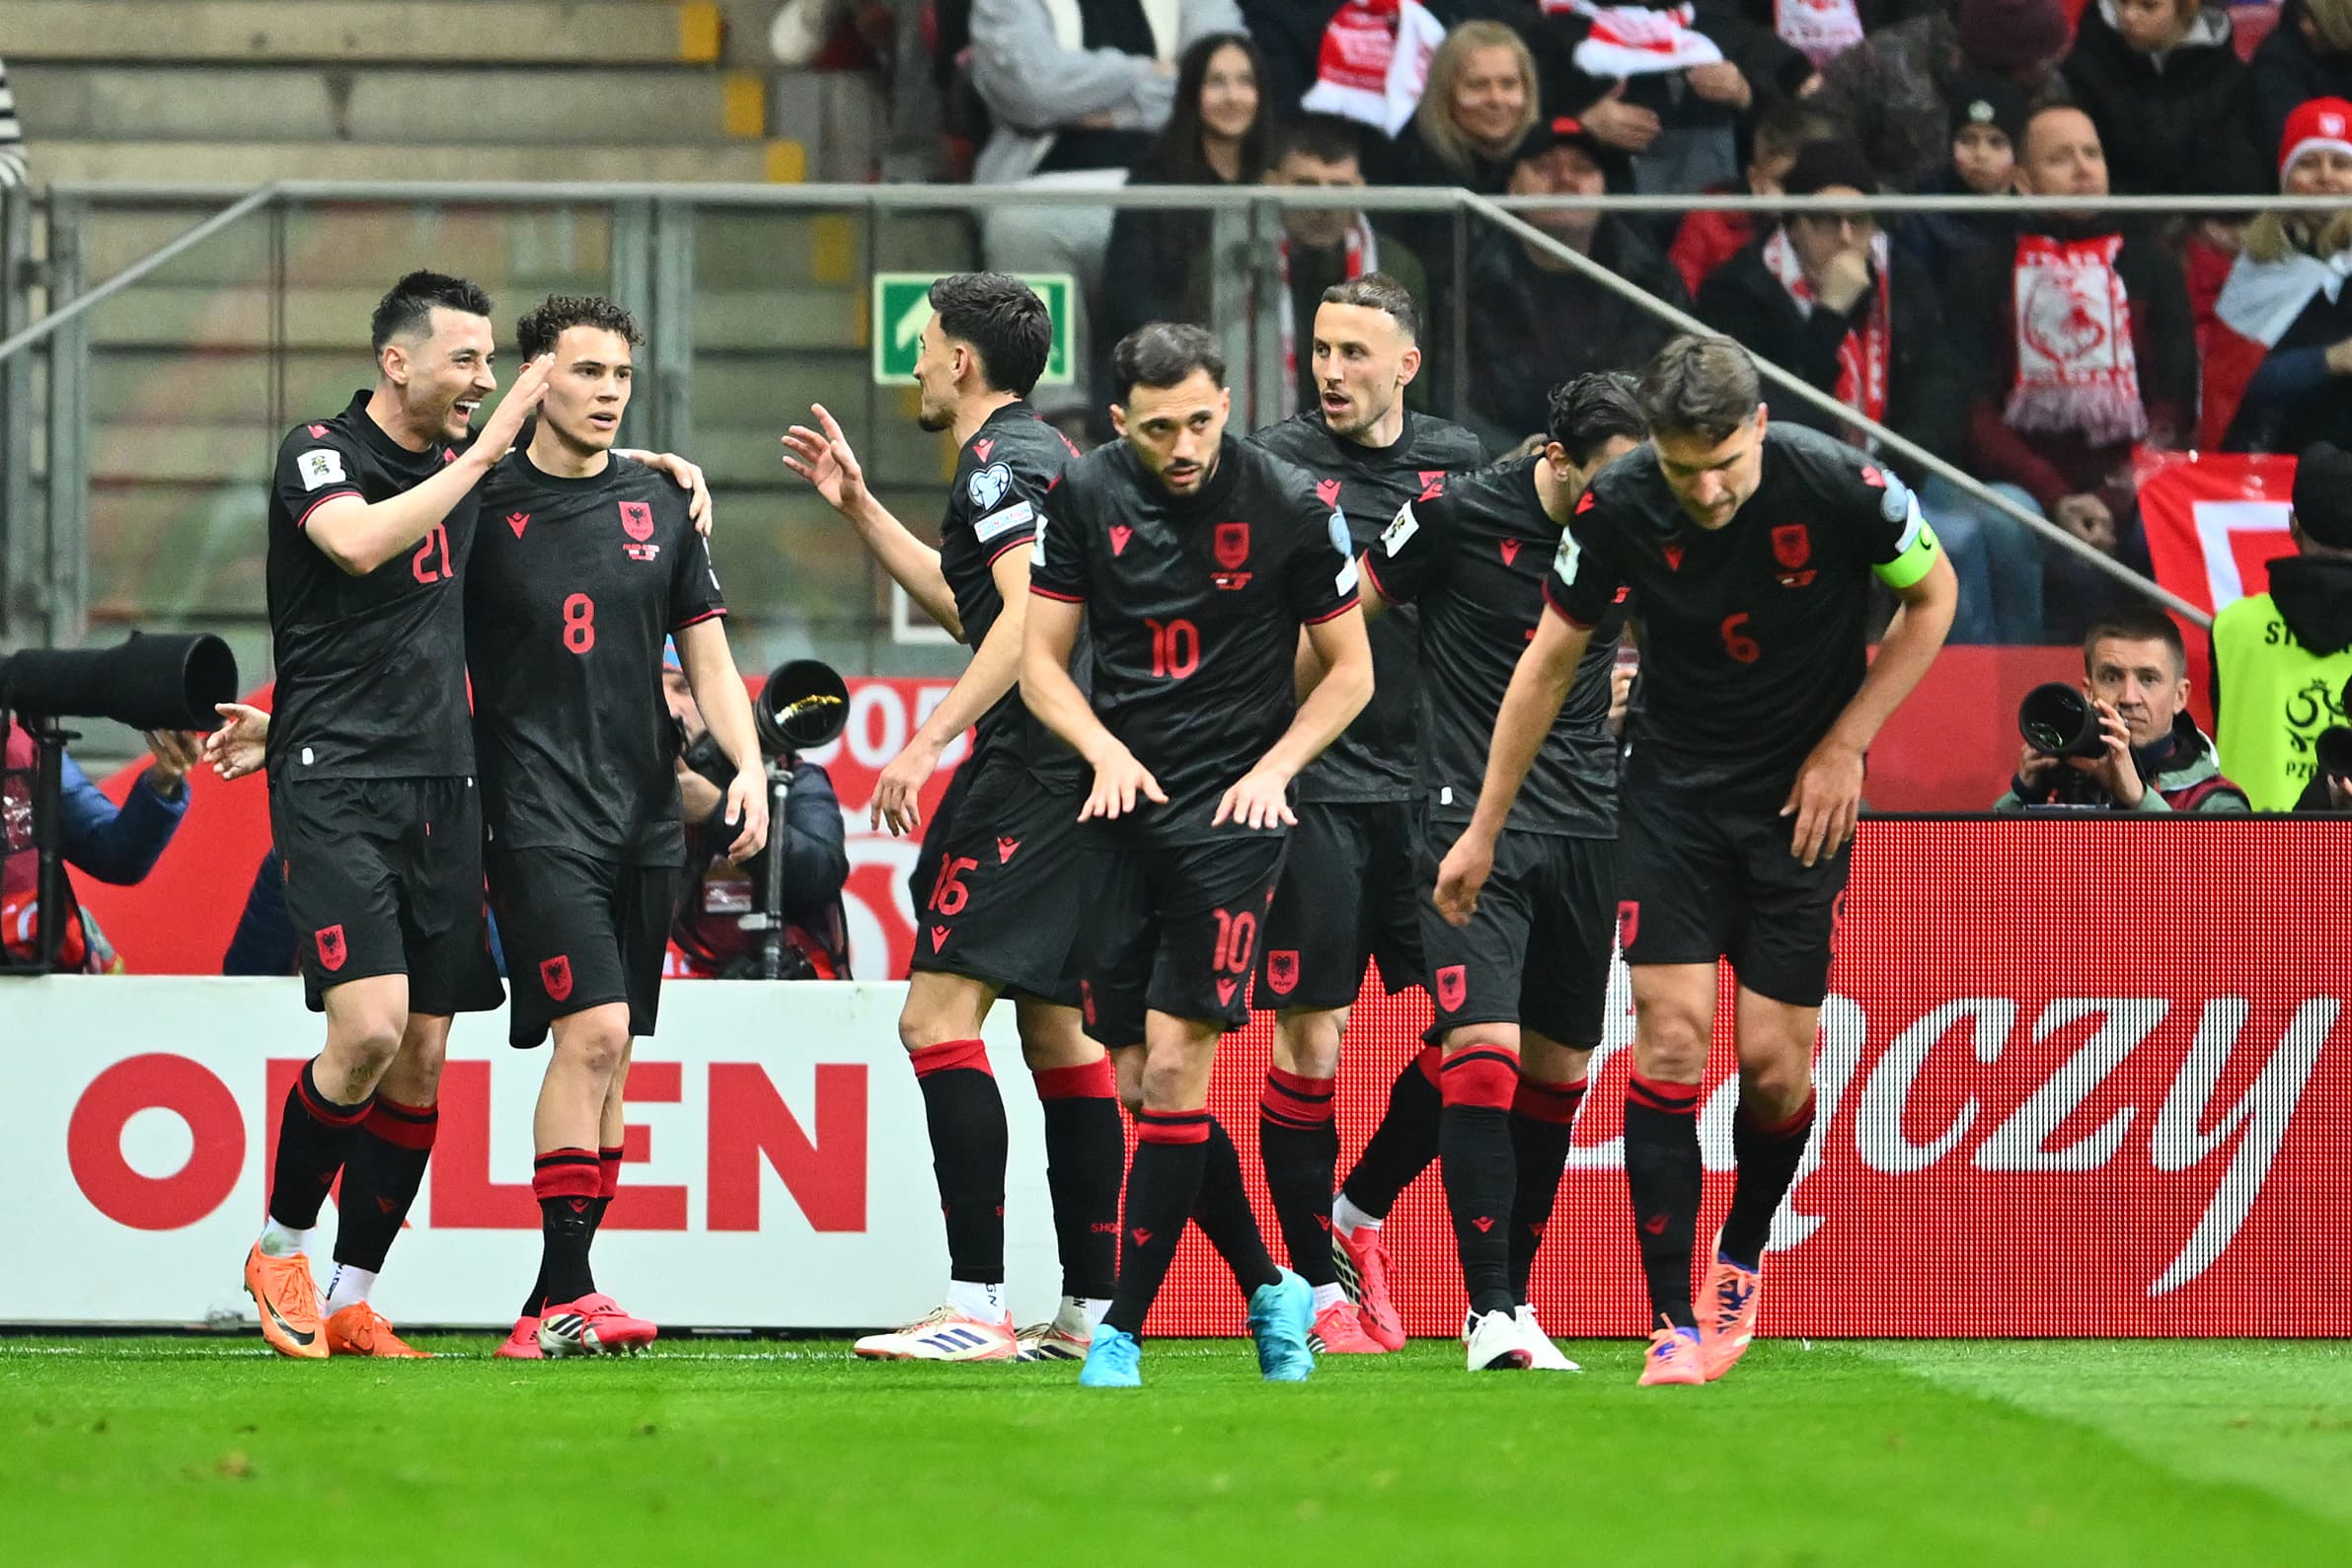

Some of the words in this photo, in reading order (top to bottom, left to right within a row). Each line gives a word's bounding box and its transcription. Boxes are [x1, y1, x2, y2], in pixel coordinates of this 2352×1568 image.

[413, 522, 453, 583] 21
[563, 592, 595, 654] 8
[1145, 618, 1200, 679] 10
[1720, 612, 1759, 663] 6
[928, 852, 979, 916] 16
[1213, 908, 1256, 974] 10
